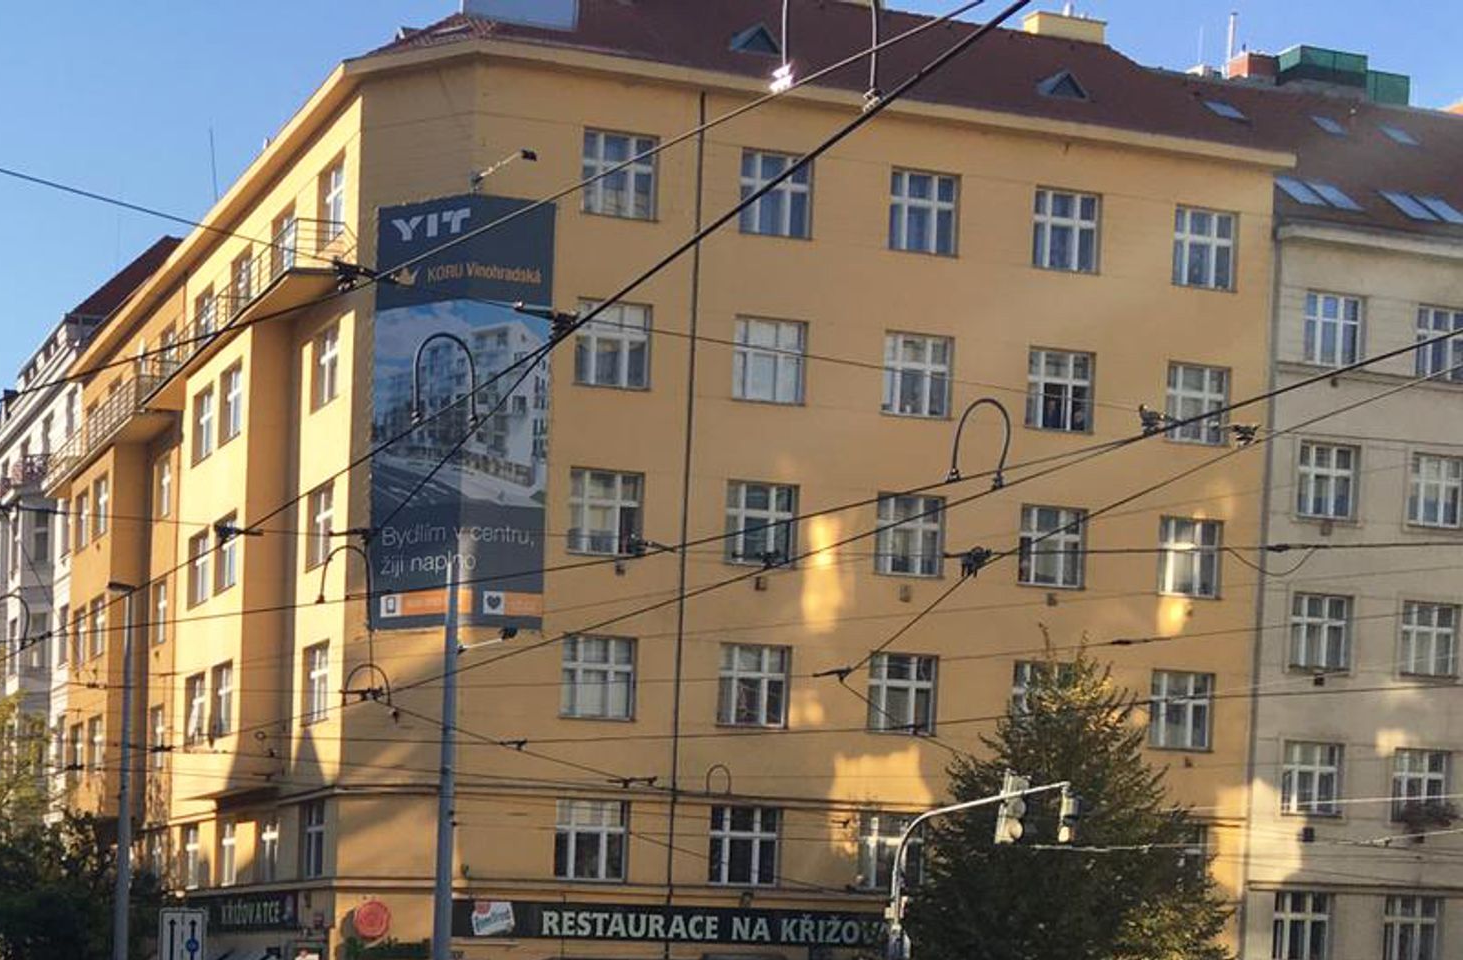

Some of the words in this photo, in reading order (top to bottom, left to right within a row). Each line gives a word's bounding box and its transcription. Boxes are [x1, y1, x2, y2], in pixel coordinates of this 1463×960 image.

[392, 208, 471, 241] YIT
[427, 264, 463, 282] KORU
[466, 262, 542, 285] Vinohradská
[381, 522, 446, 550] Bydlím
[453, 526, 466, 541] v
[469, 524, 536, 548] centru,
[541, 910, 719, 941] RESTAURACE
[731, 916, 772, 942] NA
